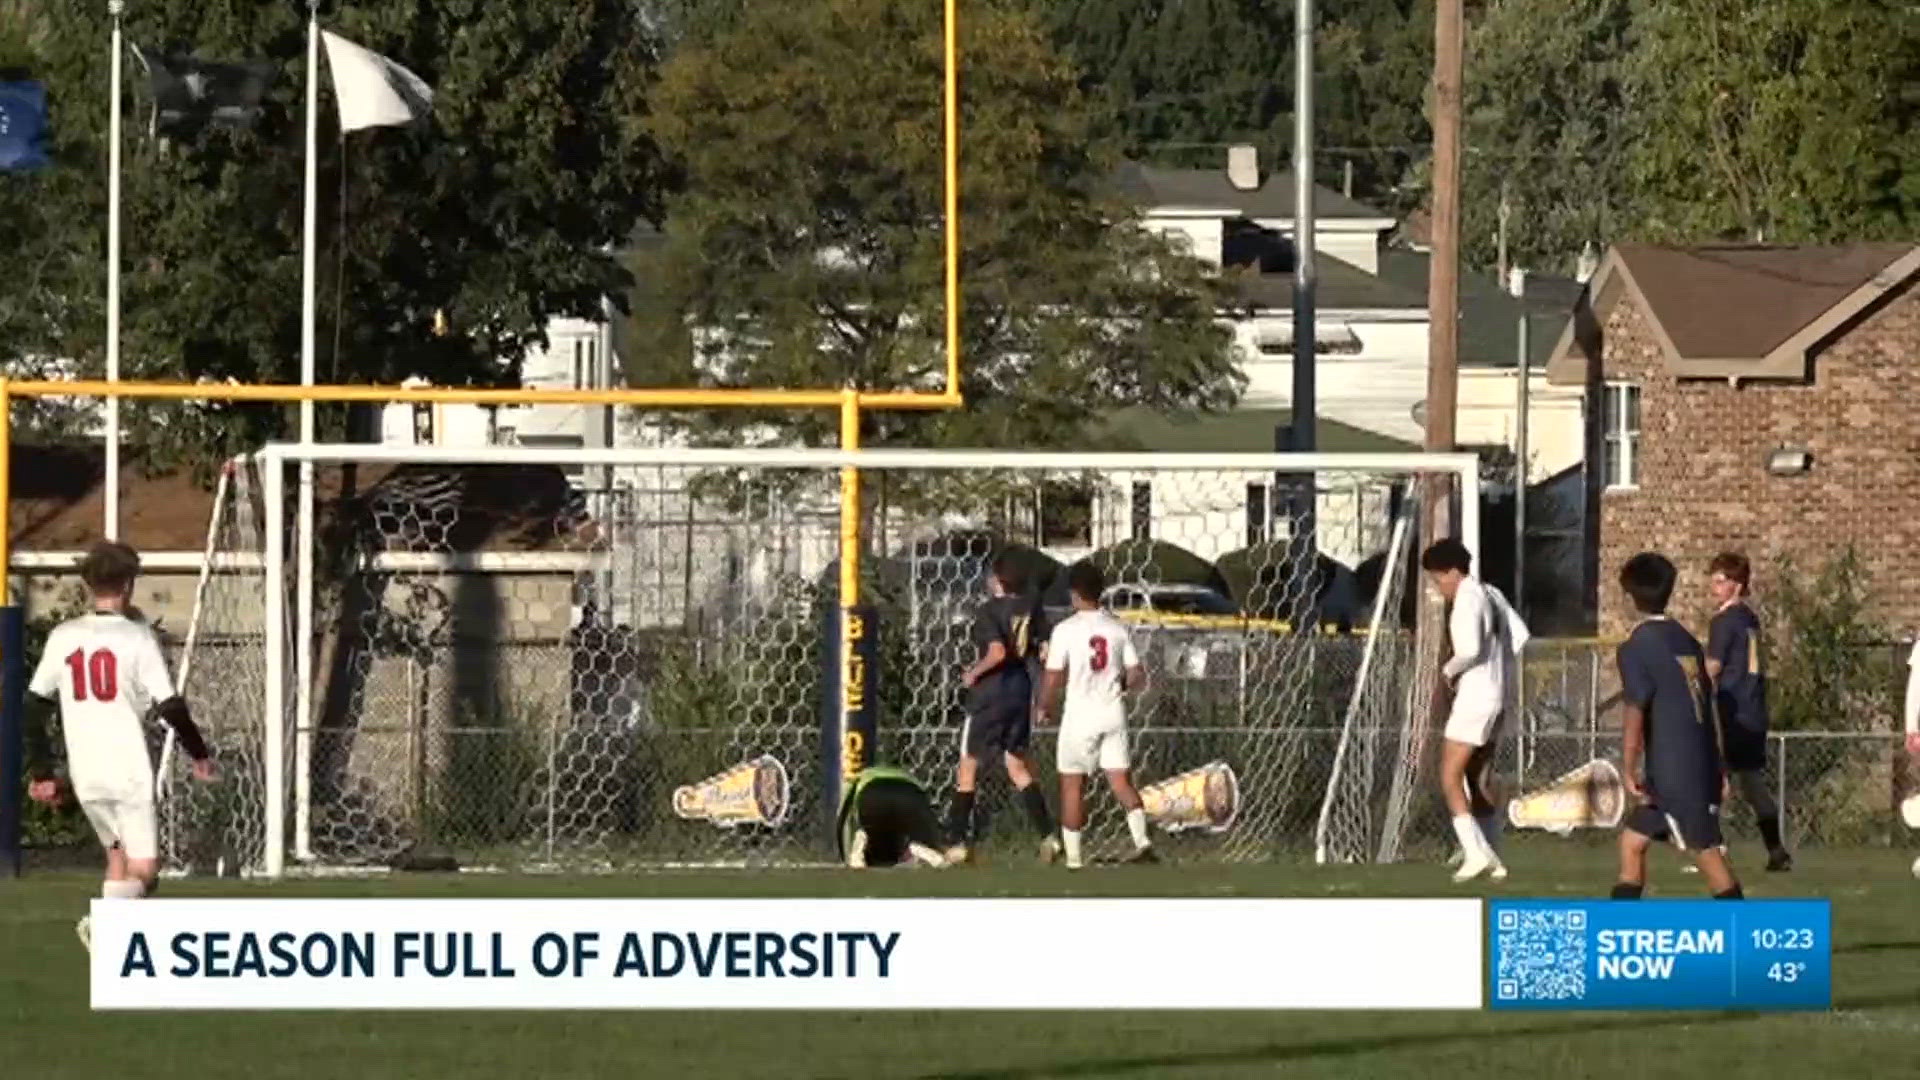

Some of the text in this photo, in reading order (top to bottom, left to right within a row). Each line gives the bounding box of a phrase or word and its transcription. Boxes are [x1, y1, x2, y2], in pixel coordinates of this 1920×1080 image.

[65, 647, 118, 702] 10
[841, 614, 865, 712] BLUE
[1088, 634, 1109, 672] 3
